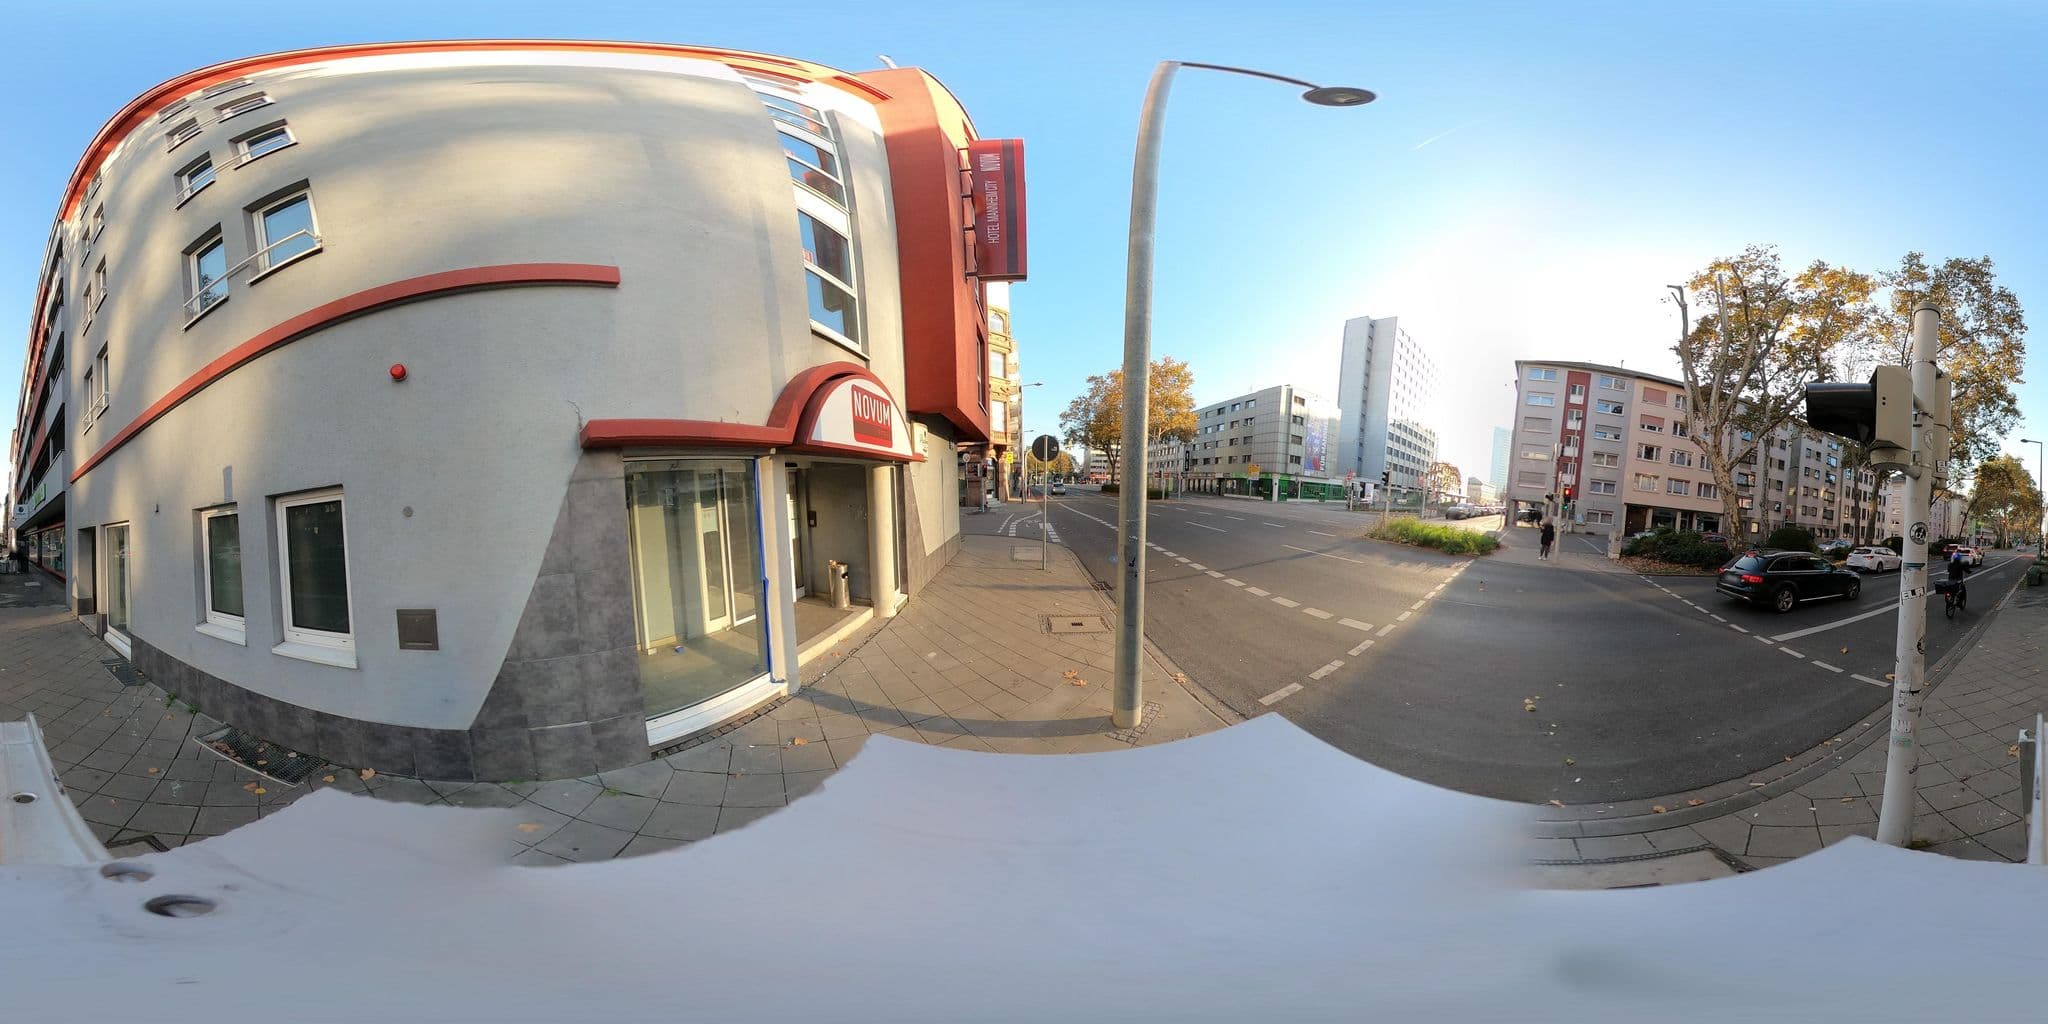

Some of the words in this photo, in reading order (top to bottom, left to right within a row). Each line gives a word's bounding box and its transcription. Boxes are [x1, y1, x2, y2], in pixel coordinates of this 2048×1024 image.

[980, 153, 1000, 171] NOVUM
[985, 180, 998, 190] CITY
[985, 190, 999, 222] MANNHEIM
[987, 223, 1000, 244] HOTEL
[854, 390, 890, 426] NOVUM
